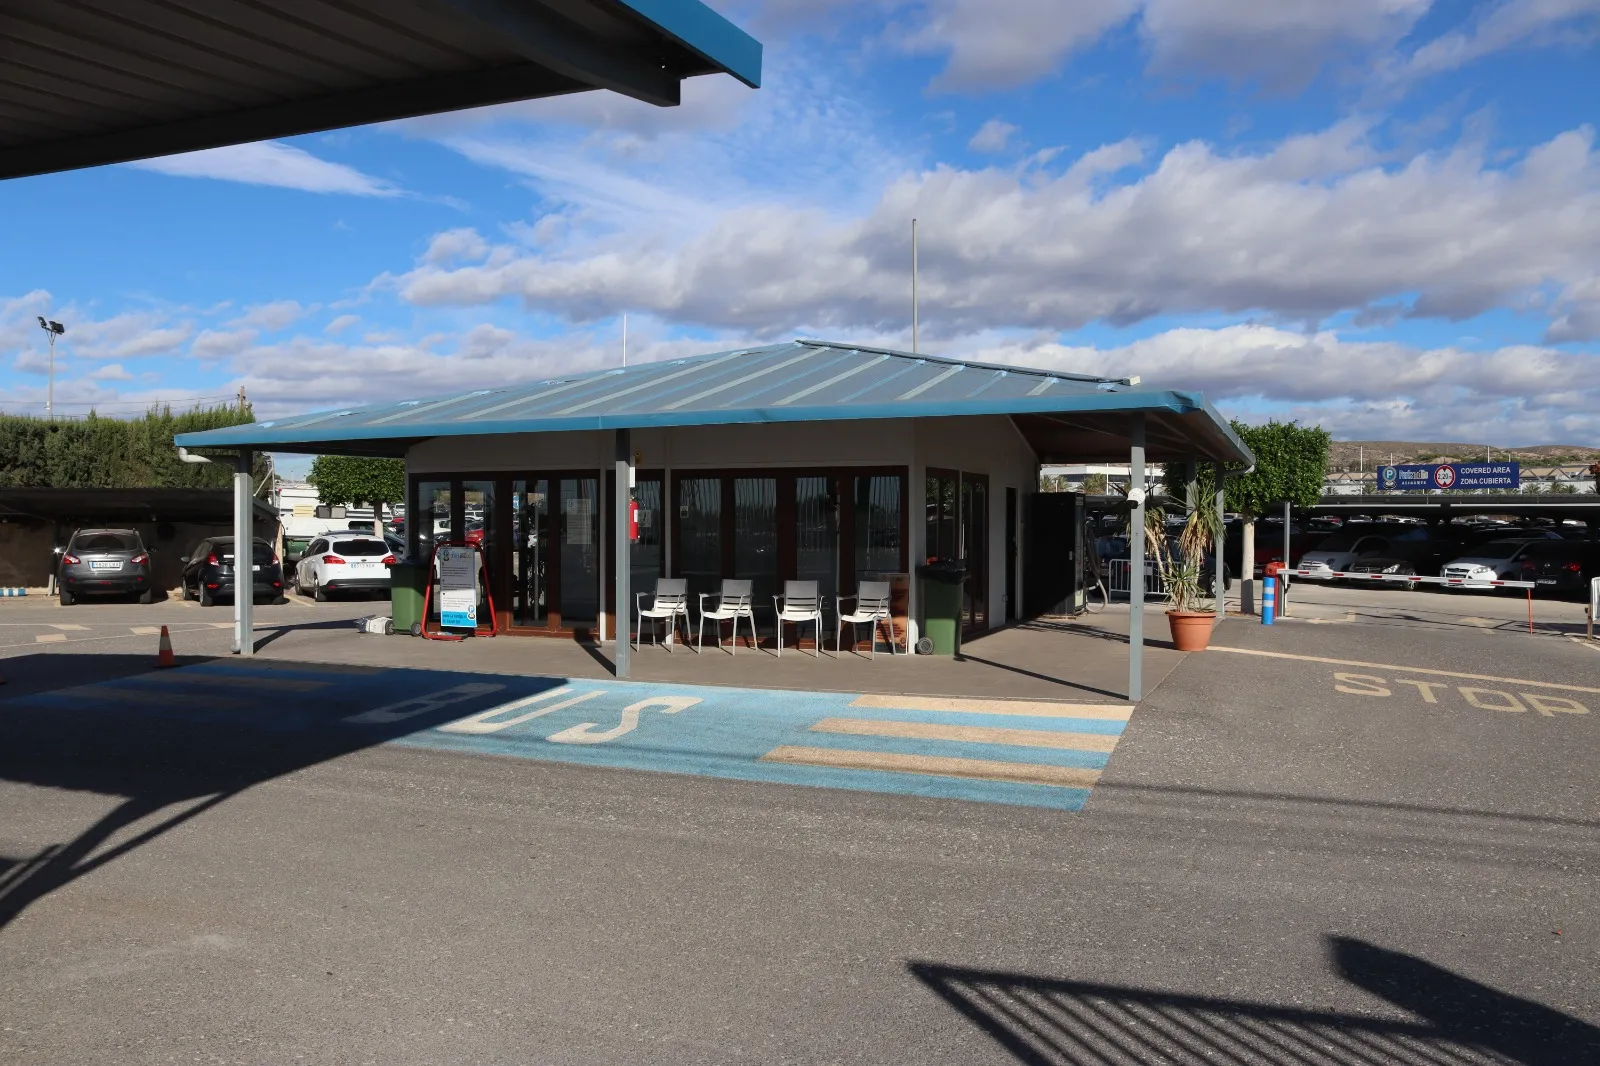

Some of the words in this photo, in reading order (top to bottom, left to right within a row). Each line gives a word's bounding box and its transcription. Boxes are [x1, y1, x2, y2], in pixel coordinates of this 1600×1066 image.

[1460, 467, 1492, 475] COVERED
[1492, 466, 1511, 474] AREA
[1479, 477, 1512, 485] CUBIERTA
[1333, 672, 1590, 717] STOP
[341, 682, 704, 744] BUS
